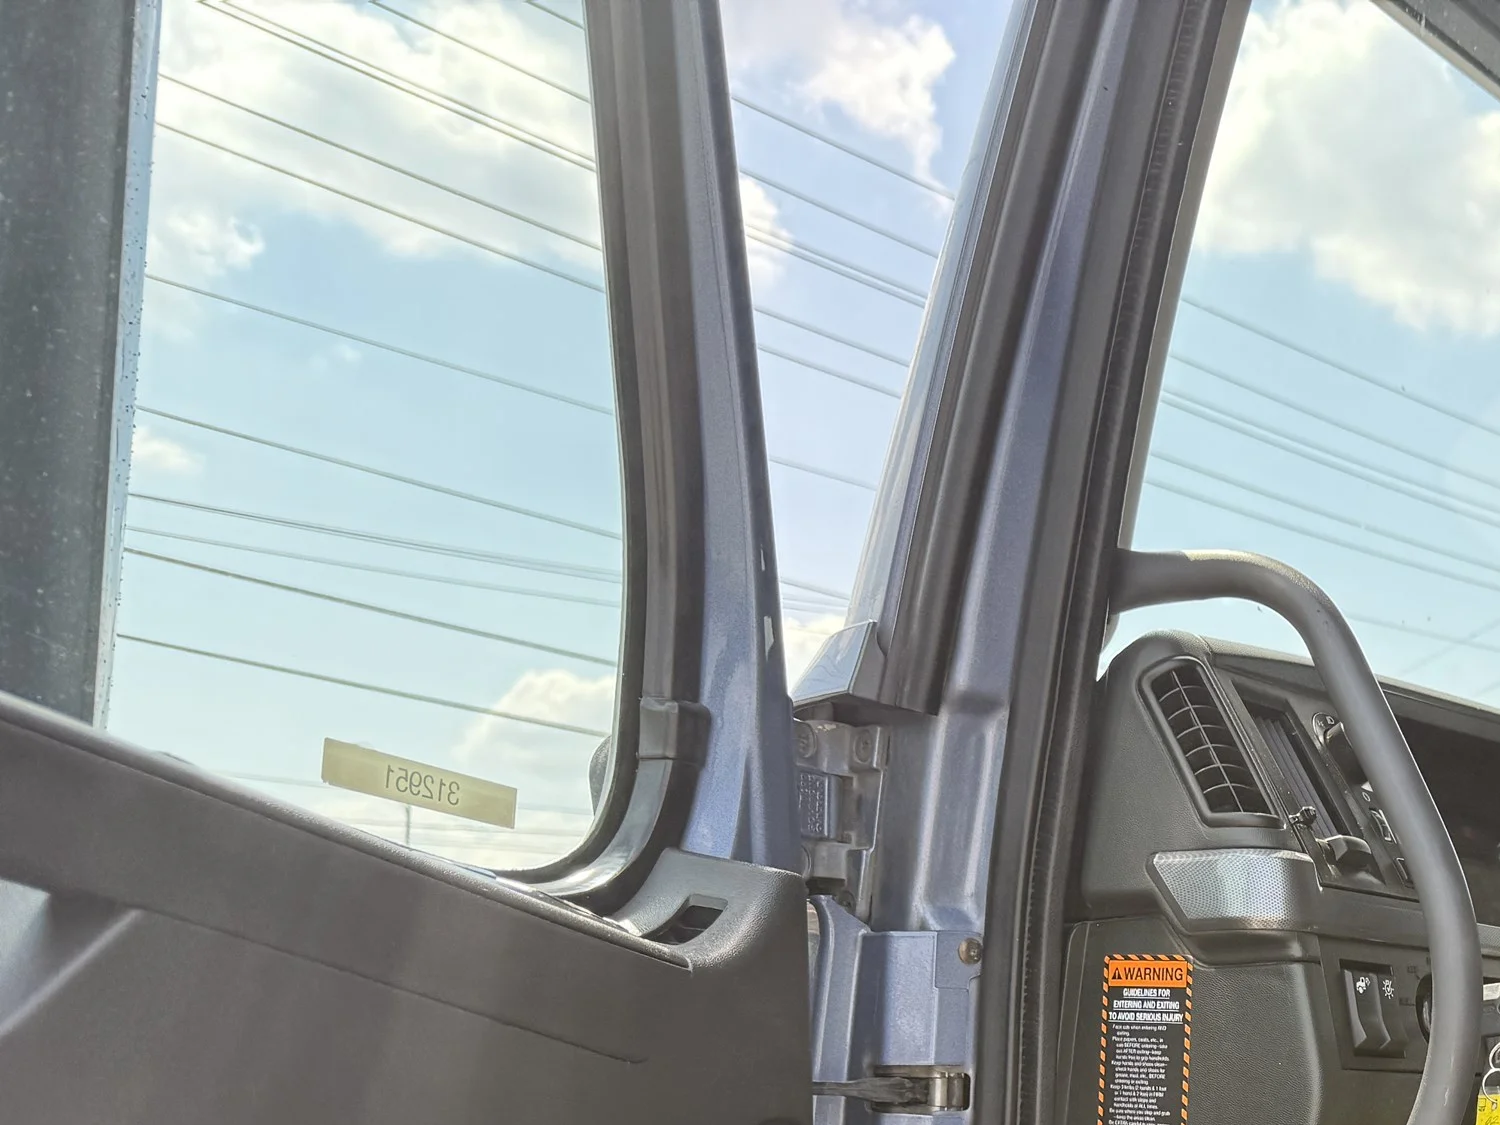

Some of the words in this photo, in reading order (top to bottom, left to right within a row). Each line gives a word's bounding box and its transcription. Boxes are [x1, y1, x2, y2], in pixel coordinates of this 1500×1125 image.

[1124, 967, 1183, 980] WARNING
[1158, 989, 1170, 997] FOR
[1113, 1000, 1142, 1008] ENTERING
[1143, 1001, 1155, 1009] AND
[1136, 1013, 1161, 1021] SERIOUS
[1162, 1014, 1183, 1022] INJURY
